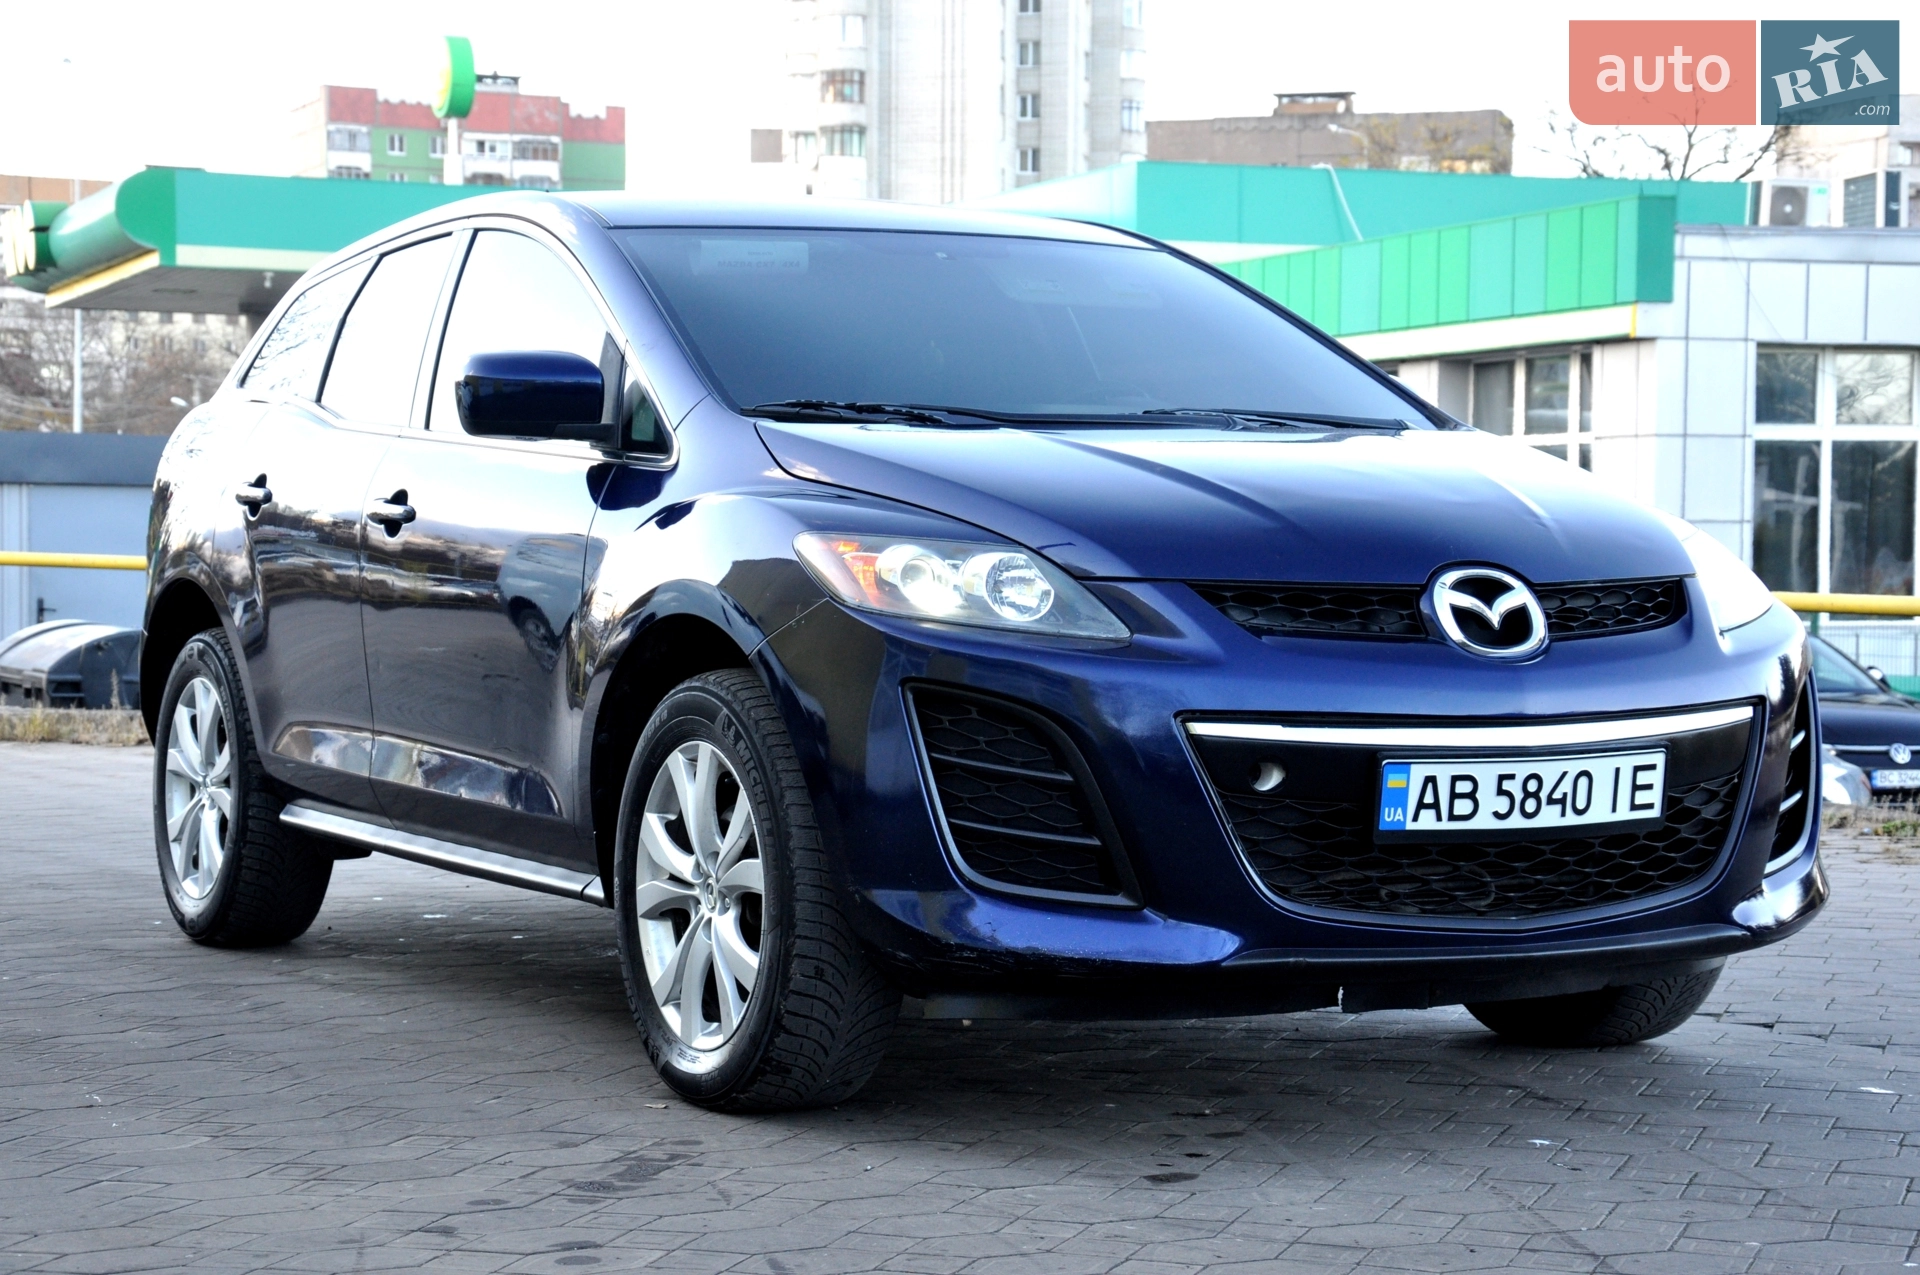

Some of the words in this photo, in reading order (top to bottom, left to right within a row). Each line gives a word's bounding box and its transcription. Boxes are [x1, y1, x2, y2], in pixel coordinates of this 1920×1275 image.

[1411, 773, 1480, 822] AB
[1491, 769, 1594, 820] 5840
[1611, 763, 1658, 813] IE
[1384, 807, 1404, 822] UA
